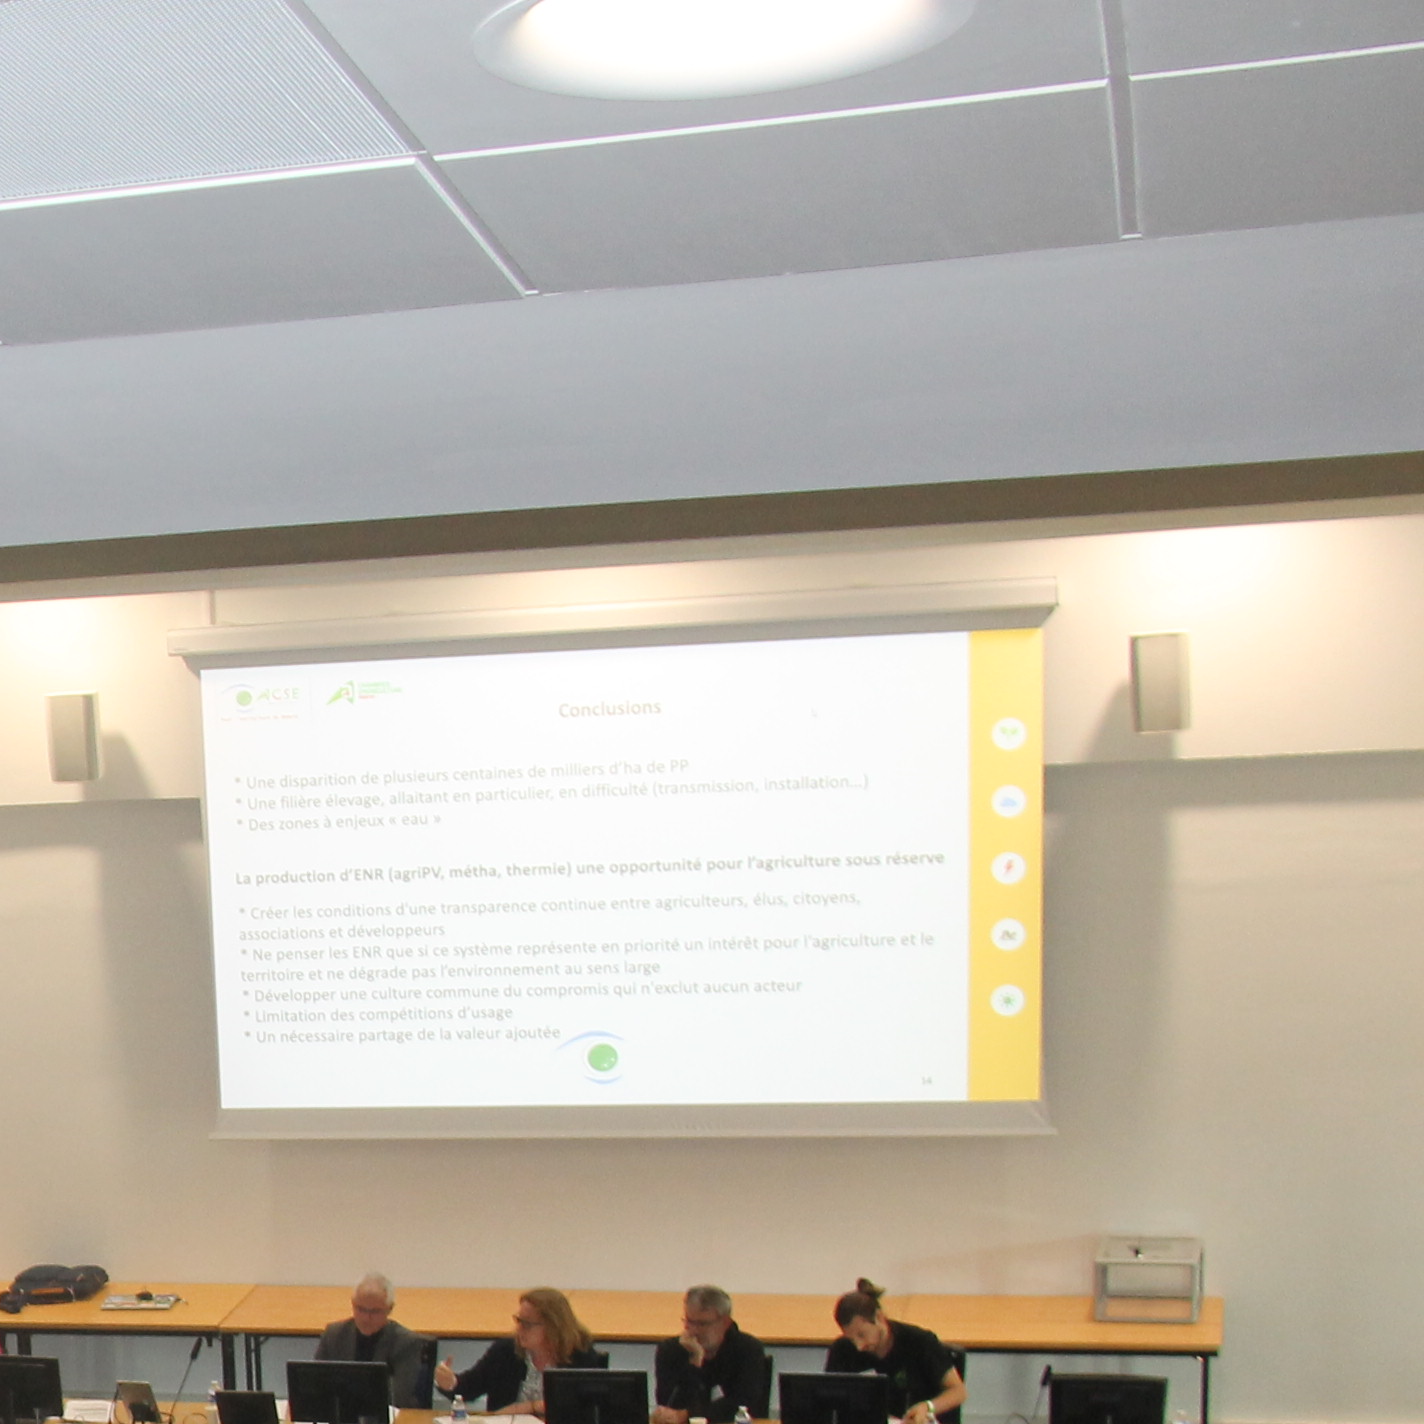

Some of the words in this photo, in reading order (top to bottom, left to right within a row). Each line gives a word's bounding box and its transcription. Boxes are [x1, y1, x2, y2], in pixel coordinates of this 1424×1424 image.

[558, 699, 662, 719] Conclusions
[246, 775, 276, 791] Une
[279, 771, 357, 790] disparition
[360, 770, 380, 785] de
[382, 768, 449, 787] plusieurs
[452, 766, 524, 782] centaines
[527, 764, 547, 779] de
[550, 761, 605, 778] milliers
[646, 759, 666, 775] de
[670, 758, 689, 773] PP
[247, 796, 276, 812] Une
[279, 793, 322, 810] filière
[388, 789, 449, 806] allaitant
[452, 791, 471, 803] en
[558, 787, 577, 799] en
[581, 781, 648, 798] difficulté
[247, 817, 277, 833] Des
[278, 818, 320, 831] zones
[322, 814, 332, 829] à
[335, 814, 384, 831] enjeux
[400, 814, 428, 827] eau
[235, 871, 251, 886] La
[255, 869, 335, 887] production
[576, 863, 605, 875] une
[608, 857, 702, 877] opportunité
[706, 859, 744, 874] pour
[845, 854, 882, 867] sous
[885, 850, 945, 866] réserve
[250, 905, 289, 921] Créer
[292, 904, 313, 920] les
[316, 902, 392, 919] conditions
[440, 901, 537, 916] transparence
[540, 898, 607, 913] continue
[610, 897, 651, 911] entre
[238, 926, 325, 942] associations
[328, 926, 344, 940] et
[346, 922, 445, 941] développeurs
[252, 948, 272, 962] Ne
[276, 949, 325, 964] penser
[328, 945, 349, 961] les
[352, 944, 382, 960] ENR
[385, 947, 414, 962] que
[417, 943, 429, 958] si
[432, 946, 449, 958] ce
[452, 941, 512, 960] système
[516, 940, 597, 958] représente
[600, 942, 620, 954] en
[623, 937, 681, 956] priorité
[684, 940, 704, 953] un
[708, 935, 759, 952] intérêt
[763, 937, 801, 953] pour
[900, 932, 917, 947] et
[920, 931, 936, 947] le
[240, 967, 304, 983] territoire
[307, 968, 323, 982] et
[326, 969, 345, 981] ne
[348, 964, 408, 983] dégrade
[411, 967, 436, 982] pas
[564, 964, 582, 977] au
[586, 963, 620, 976] sens
[623, 959, 661, 978] large
[254, 987, 337, 1006] Développer
[339, 989, 368, 1003] une
[371, 985, 422, 1002] culture
[425, 986, 500, 1001] commune
[502, 983, 522, 999] du
[526, 982, 610, 1000] compromis
[612, 981, 637, 999] qui
[703, 982, 749, 995] aucun
[753, 980, 803, 994] acteur
[255, 1008, 326, 1024] Limitation
[329, 1007, 355, 1023] des
[358, 1005, 454, 1024] compétitions
[256, 1030, 276, 1044] Un
[279, 1028, 355, 1044] nécessaire
[358, 1029, 413, 1045] partage
[416, 1026, 436, 1042] de
[439, 1026, 452, 1042] la
[455, 1025, 502, 1041] valeur
[504, 1025, 561, 1043] ajoutée
